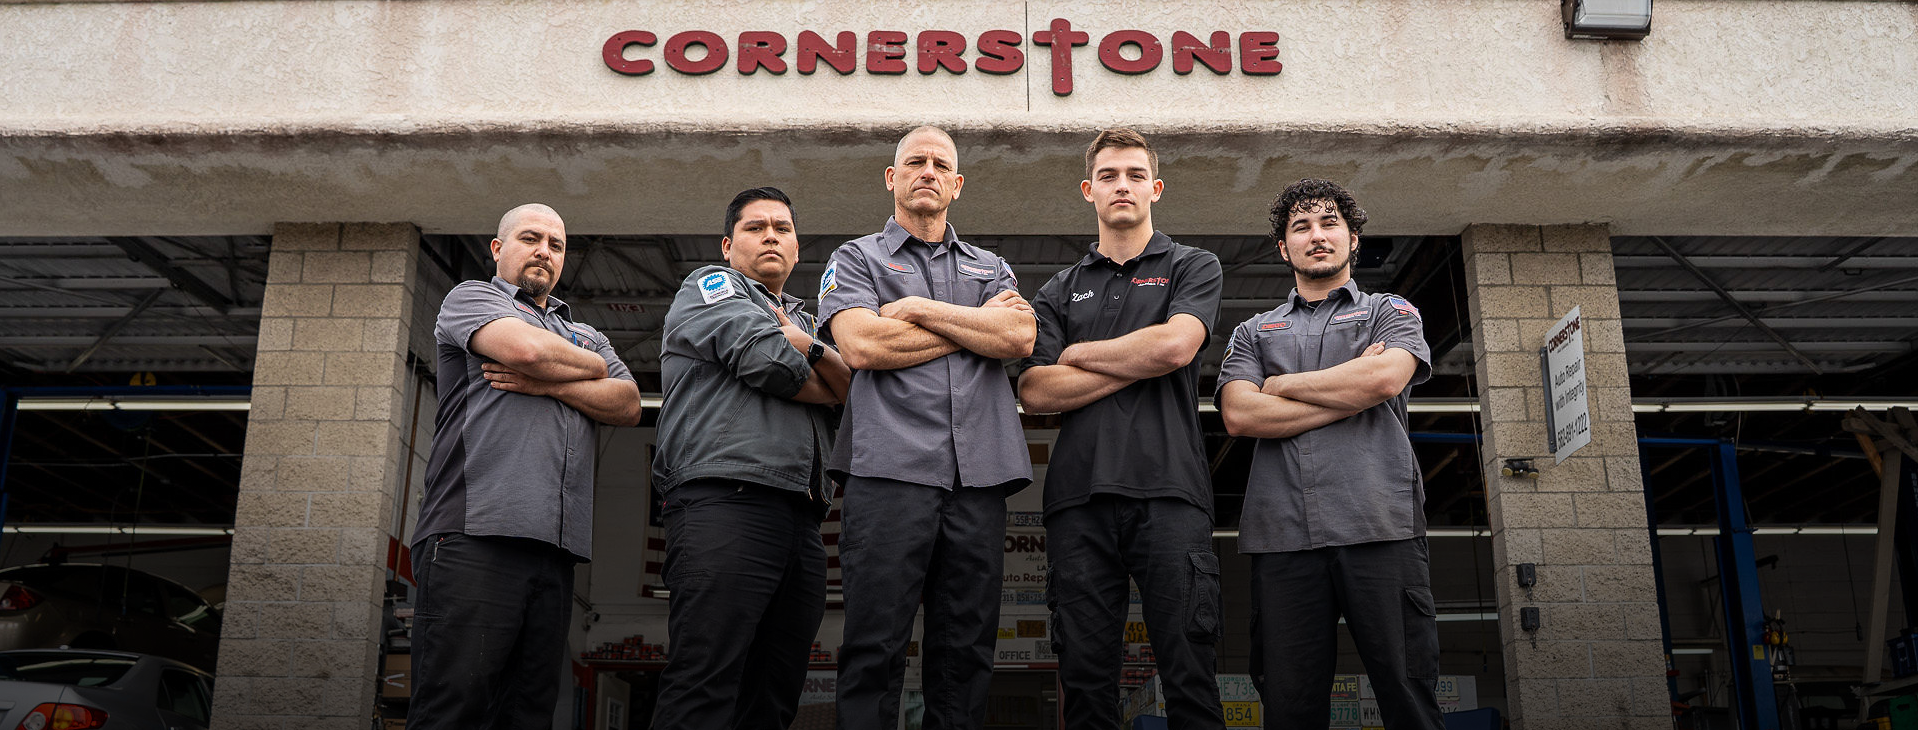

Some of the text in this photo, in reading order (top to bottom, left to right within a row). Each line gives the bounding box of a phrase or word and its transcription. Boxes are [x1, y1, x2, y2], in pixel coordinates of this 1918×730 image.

[602, 17, 1283, 97] CORNERSTONE
[1071, 289, 1095, 302] Zach
[1548, 316, 1580, 353] CORNERSTONE
[1554, 356, 1581, 389] Auto Repair
[1555, 379, 1584, 411] with Integrity
[1004, 536, 1045, 552] ORN
[1003, 574, 1020, 582] uto
[999, 651, 1030, 660] OFFICE
[804, 678, 835, 693] RNE
[1234, 682, 1255, 696] 738
[1331, 682, 1346, 692] NTA
[1346, 682, 1358, 692] FE
[1226, 707, 1252, 721] 854
[1330, 707, 1358, 720] 6778
